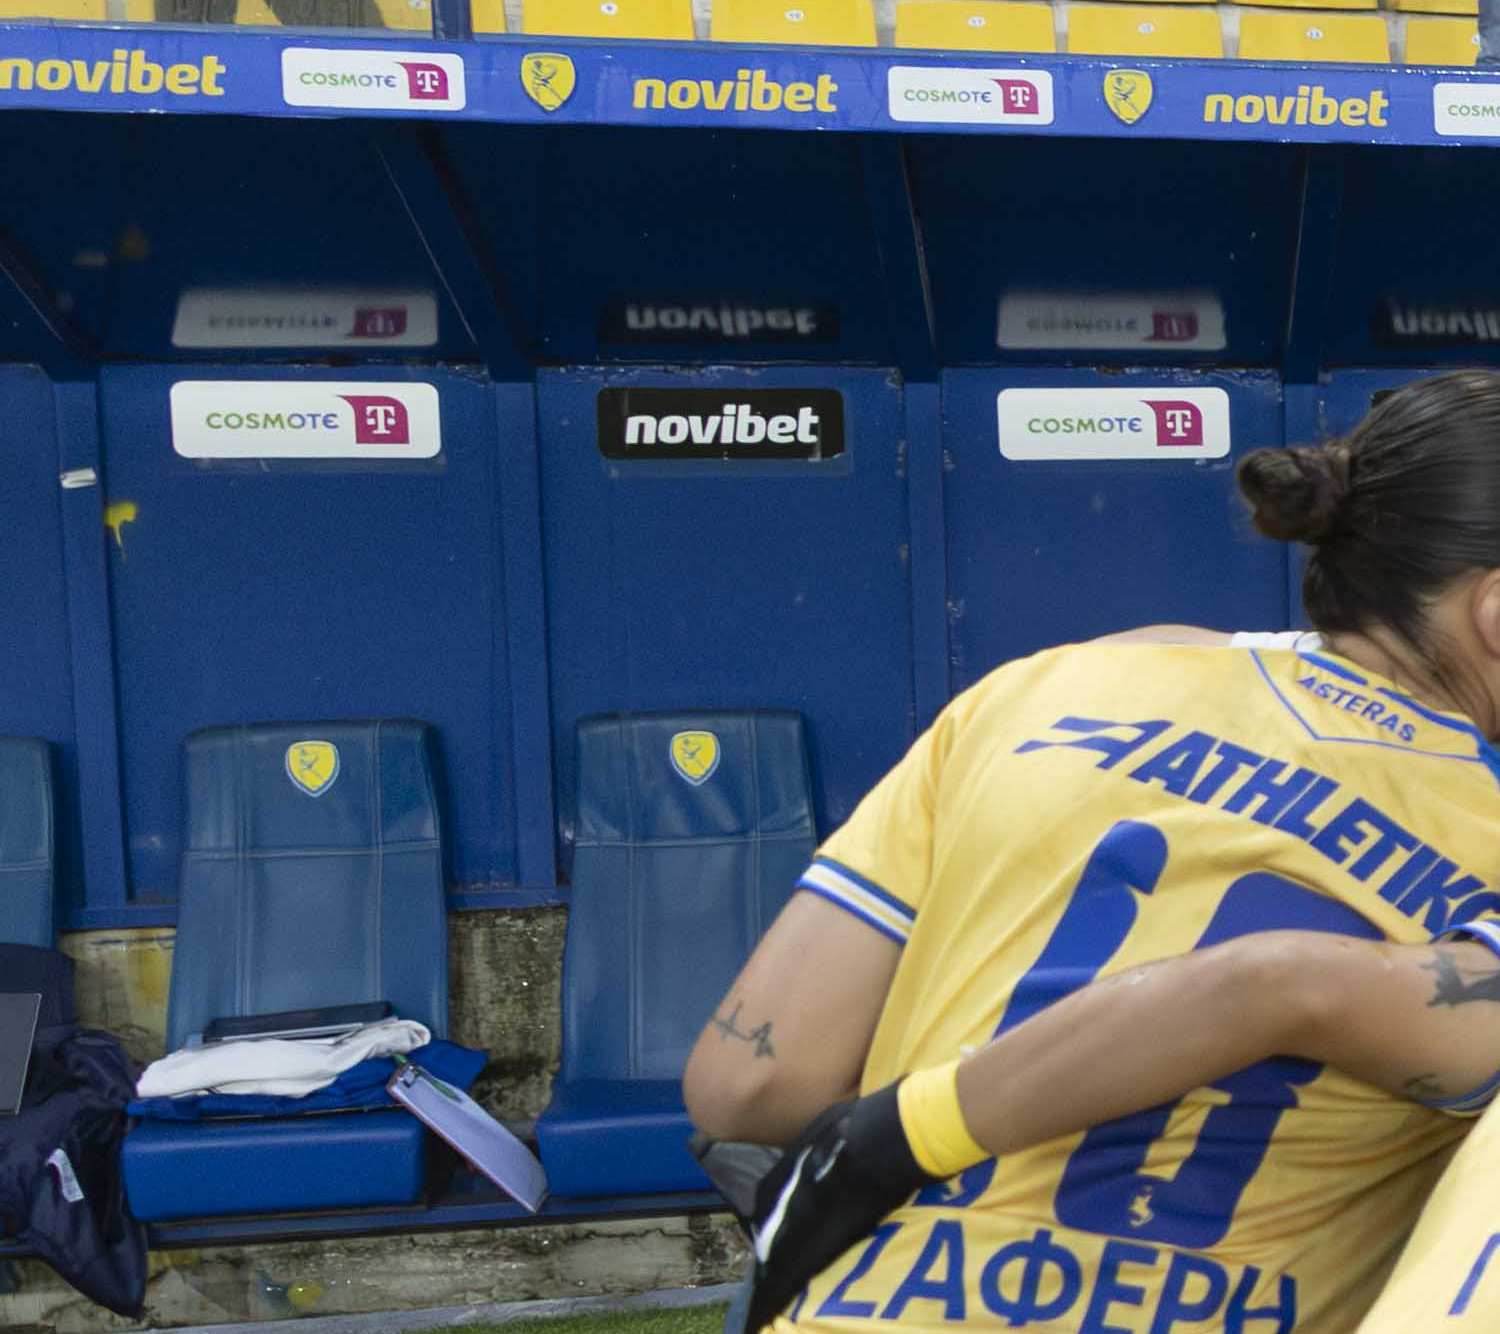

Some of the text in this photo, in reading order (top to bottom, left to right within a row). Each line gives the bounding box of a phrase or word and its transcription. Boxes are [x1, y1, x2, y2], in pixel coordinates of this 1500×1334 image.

[0, 50, 226, 96] novibet
[300, 72, 397, 89] COSMOTE
[633, 69, 837, 113] novibet
[904, 88, 992, 104] COSMOTE
[1204, 85, 1388, 127] novibet
[205, 411, 340, 431] COSMOTE
[624, 404, 819, 445] novibet
[1027, 416, 1142, 434] COSMOTE
[1297, 676, 1417, 742] ASTERAS
